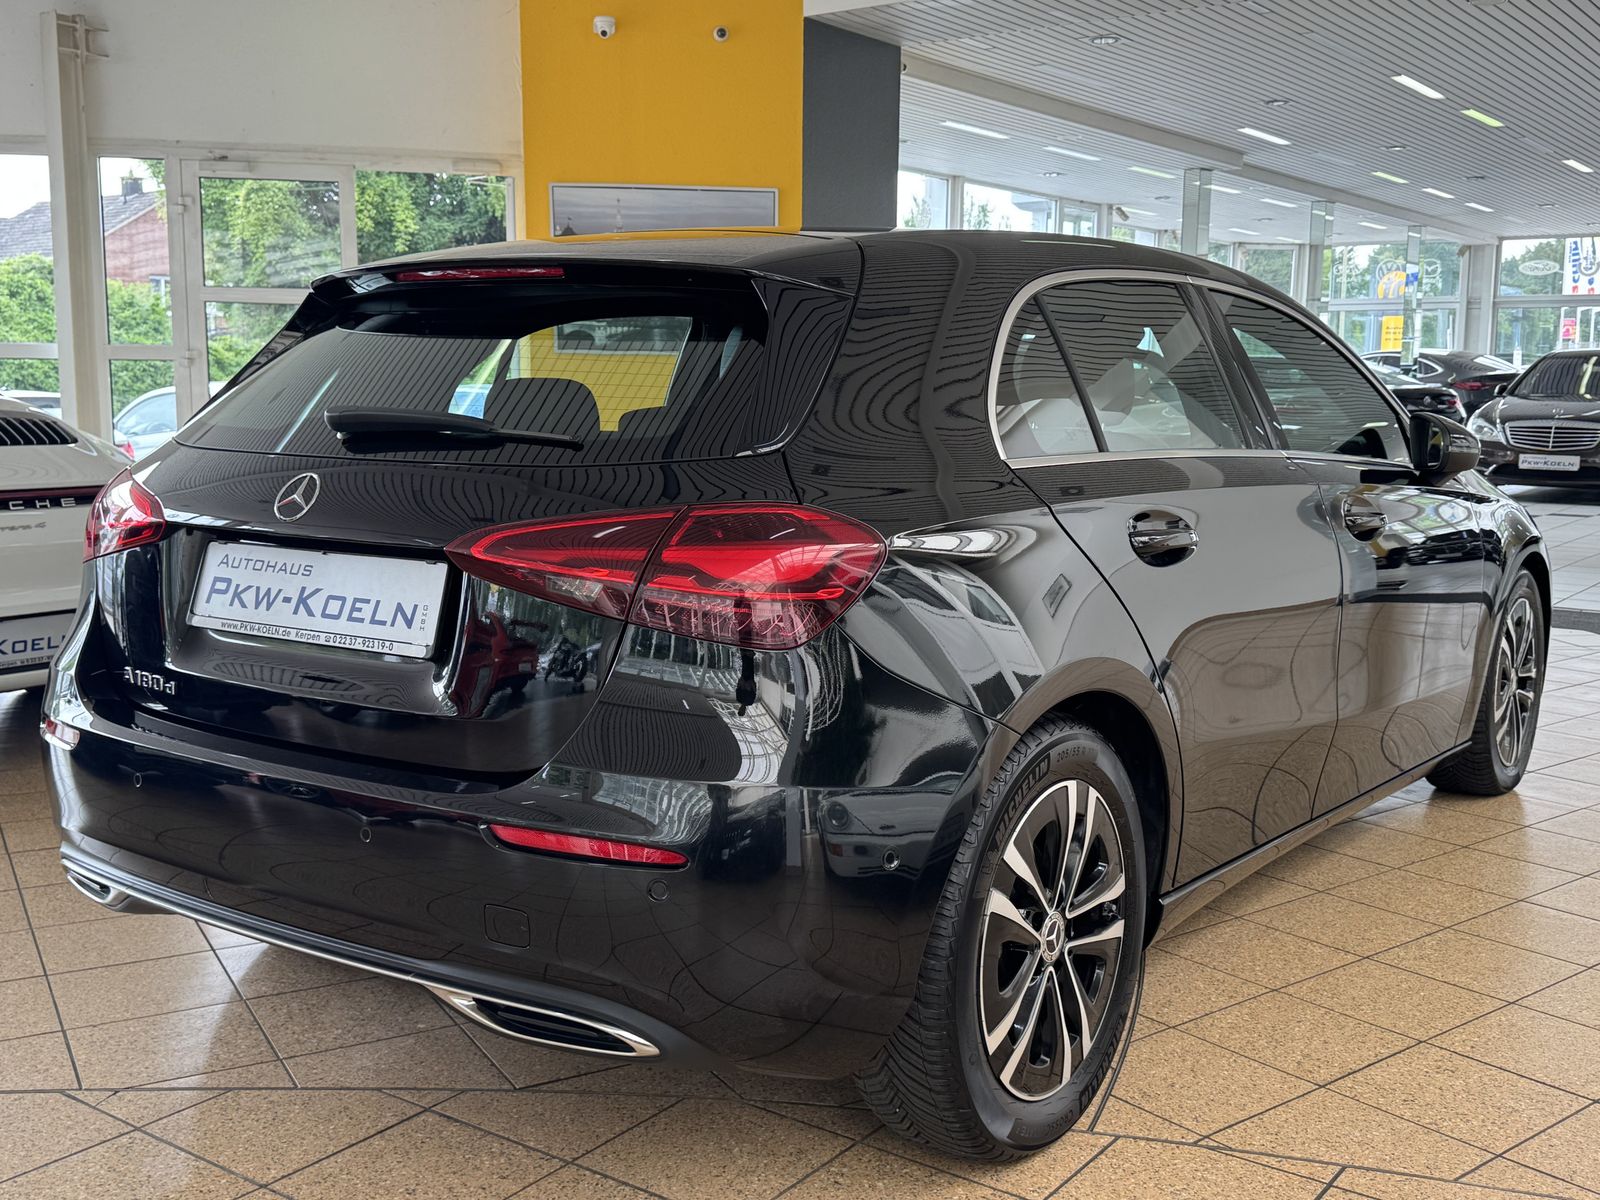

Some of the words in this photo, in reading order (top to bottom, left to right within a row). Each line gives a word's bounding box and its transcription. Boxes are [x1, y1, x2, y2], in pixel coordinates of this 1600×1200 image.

[217, 553, 314, 577] AUTOHAUS
[205, 576, 419, 630] PKW-KOELN
[221, 621, 292, 638] www.PKW-KOELN.de
[294, 630, 321, 642] Kerpen
[0, 635, 66, 655] KOEL
[995, 758, 1049, 846] MICHELIN
